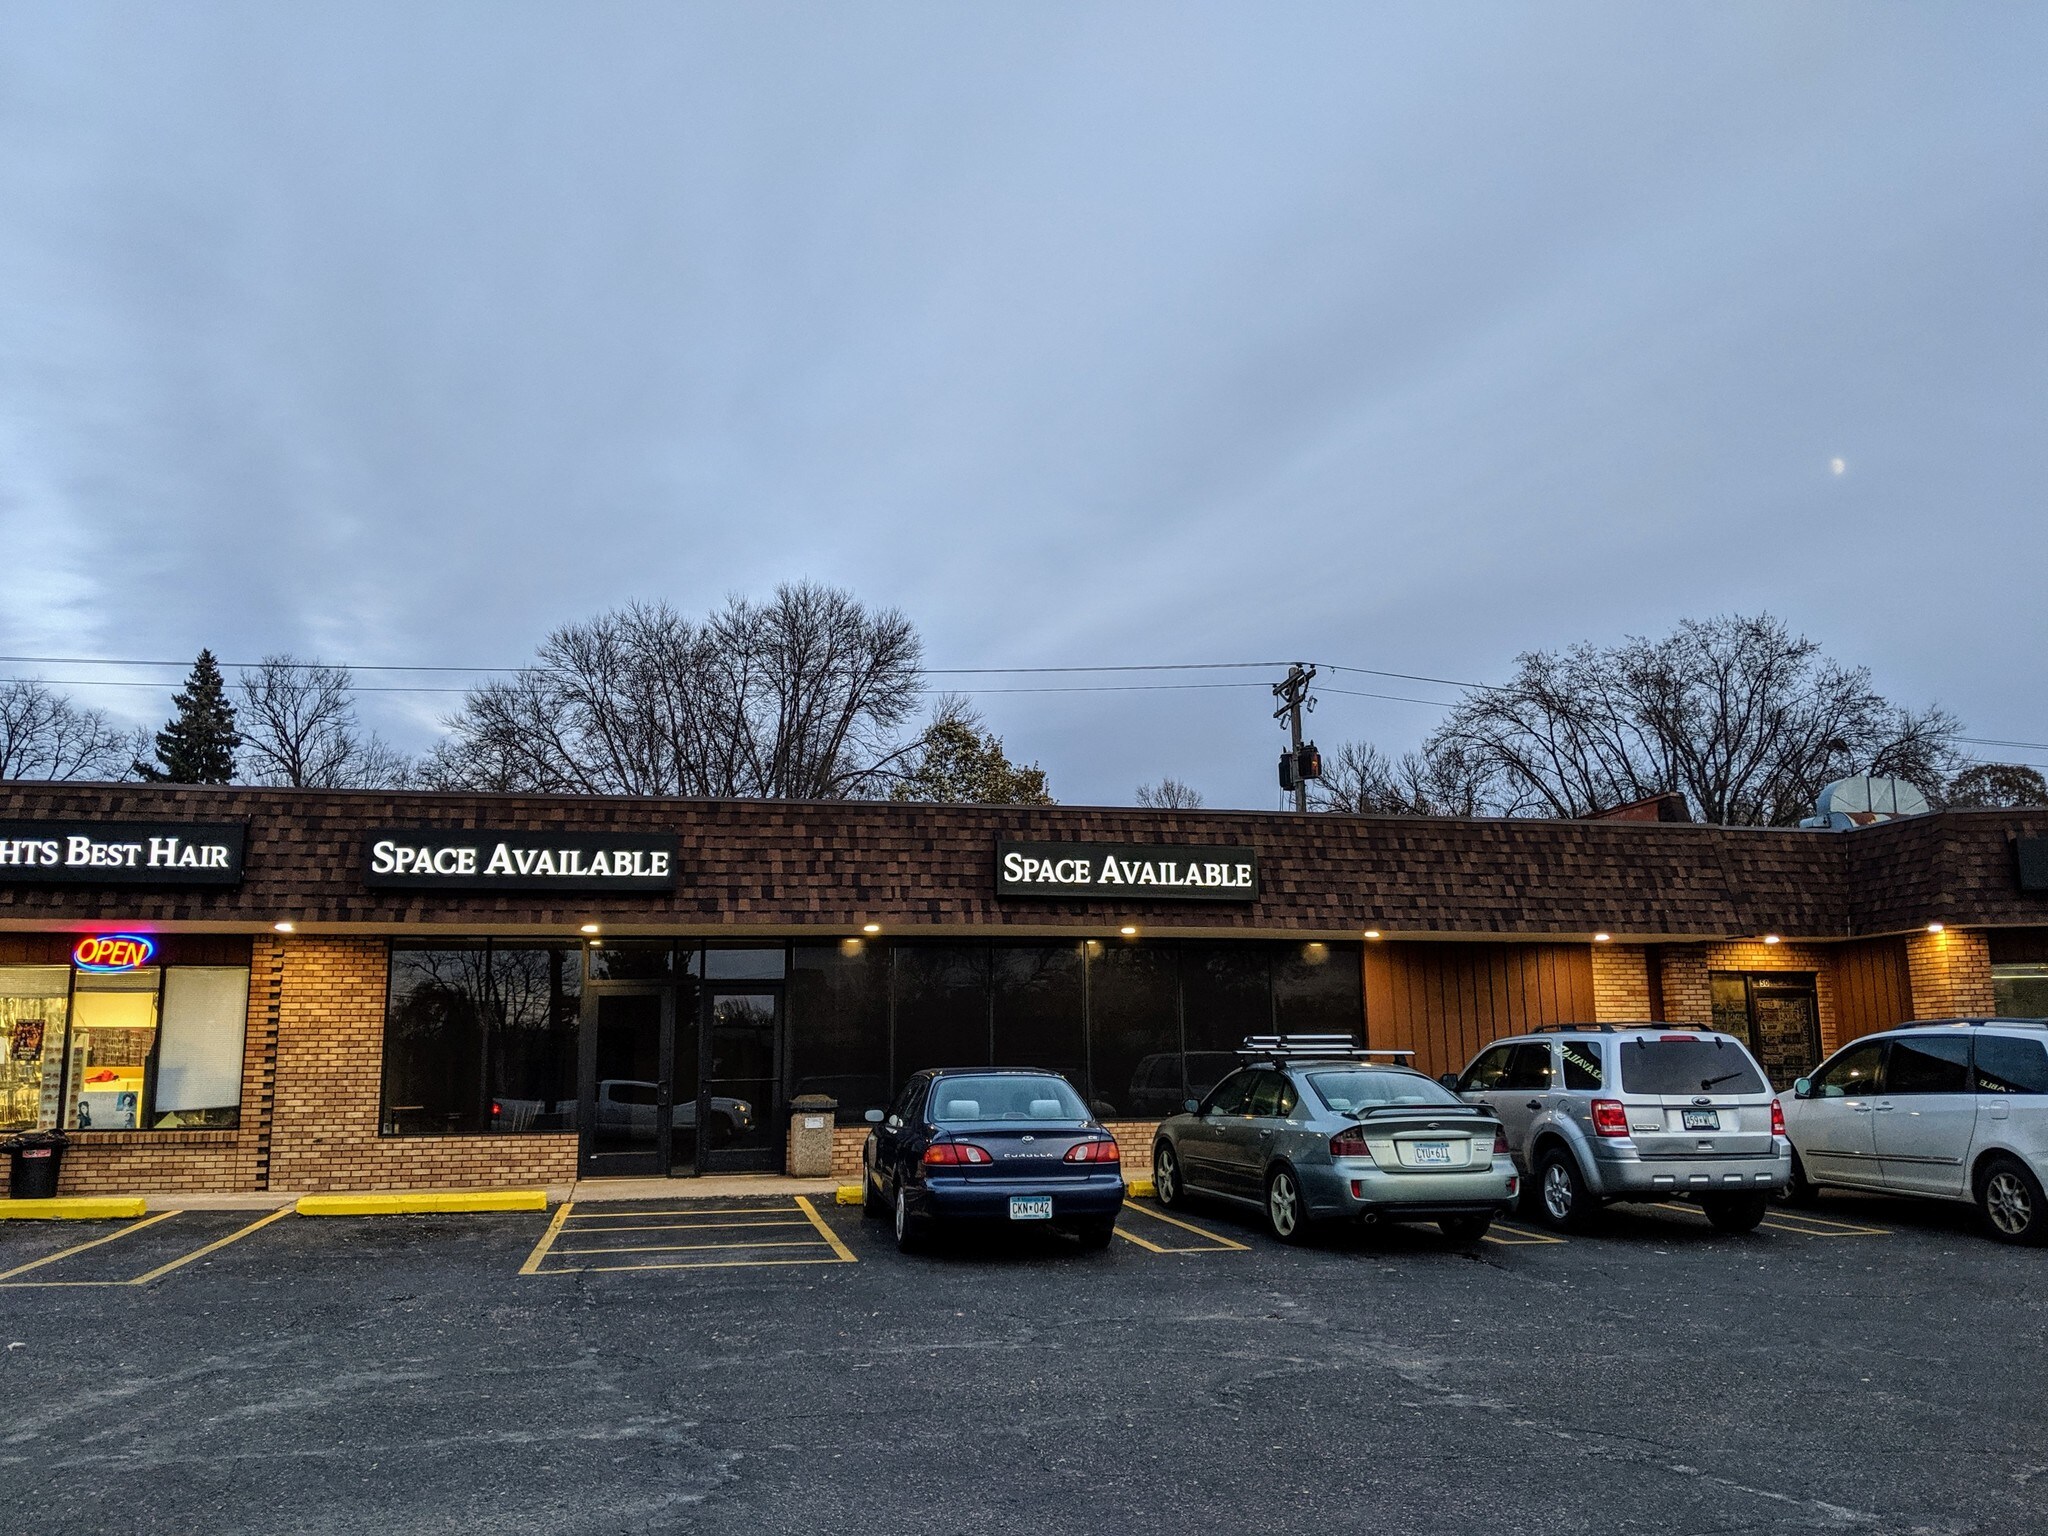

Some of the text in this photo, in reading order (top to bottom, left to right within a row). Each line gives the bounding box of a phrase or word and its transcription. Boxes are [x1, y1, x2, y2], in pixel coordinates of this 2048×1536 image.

[0, 836, 229, 868] HTS BEST HAIR
[371, 841, 669, 877] SPACE AVAILABLE
[1003, 852, 1253, 888] SPACE AVAILABLE
[77, 938, 146, 966] OPEN
[1012, 1202, 1050, 1214] CKN 042
